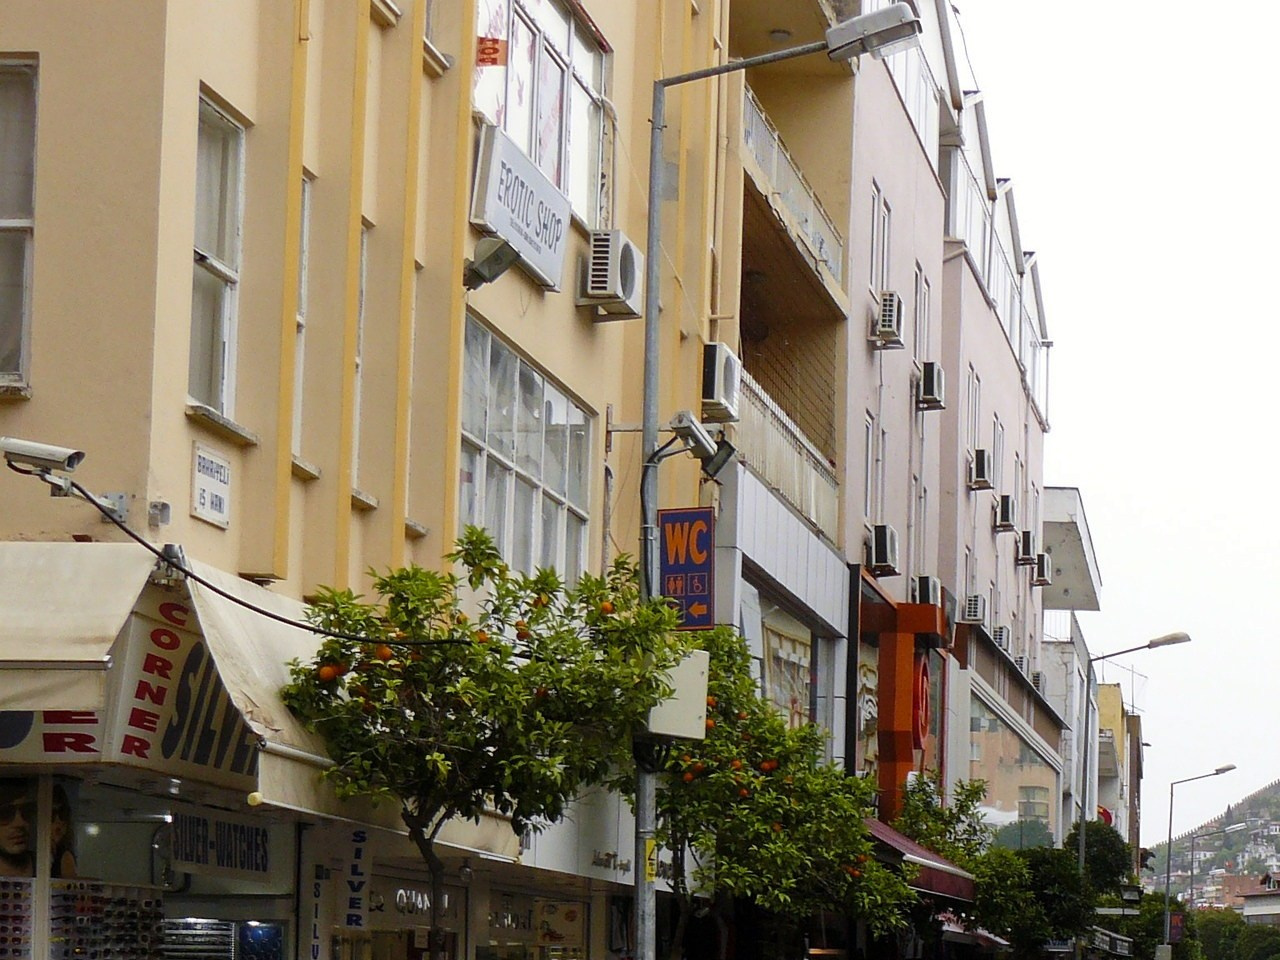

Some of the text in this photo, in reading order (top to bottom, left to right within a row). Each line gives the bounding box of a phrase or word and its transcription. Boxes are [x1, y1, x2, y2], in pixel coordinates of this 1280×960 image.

[498, 160, 534, 228] EROTIC
[535, 201, 562, 254] SHOP
[665, 521, 707, 565] WC
[121, 602, 190, 760] CORNER
[346, 830, 367, 926] SILVER
